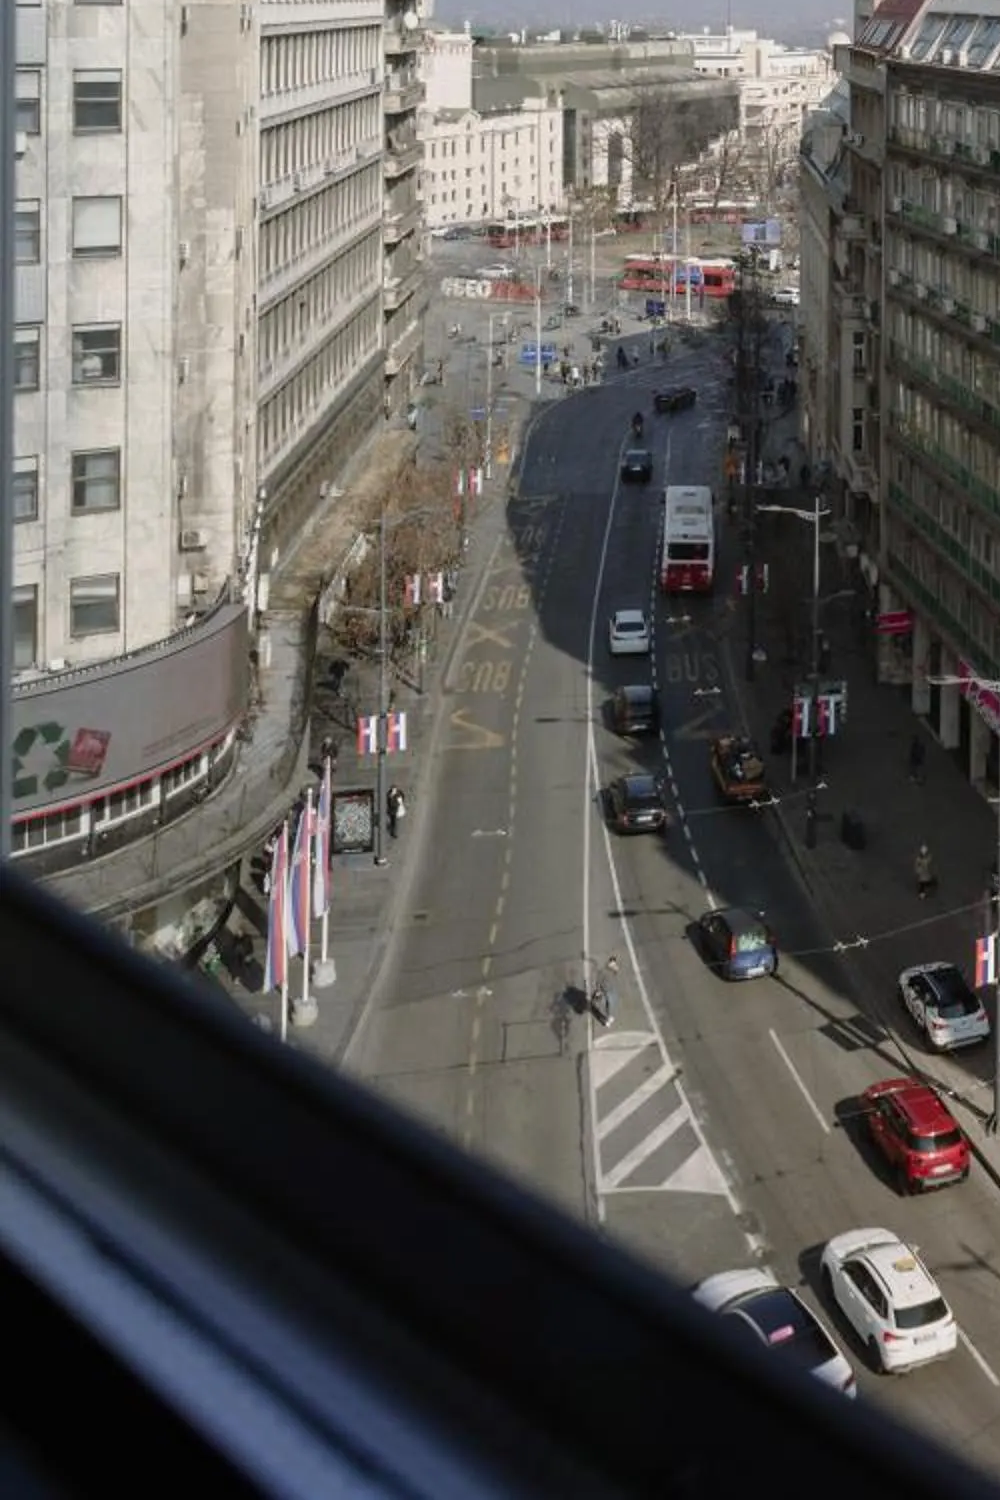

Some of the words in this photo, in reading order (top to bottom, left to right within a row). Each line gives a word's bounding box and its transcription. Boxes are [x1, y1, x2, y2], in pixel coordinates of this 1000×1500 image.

[483, 583, 530, 610] BUS
[459, 660, 512, 691] BUS
[666, 652, 719, 682] BUS
